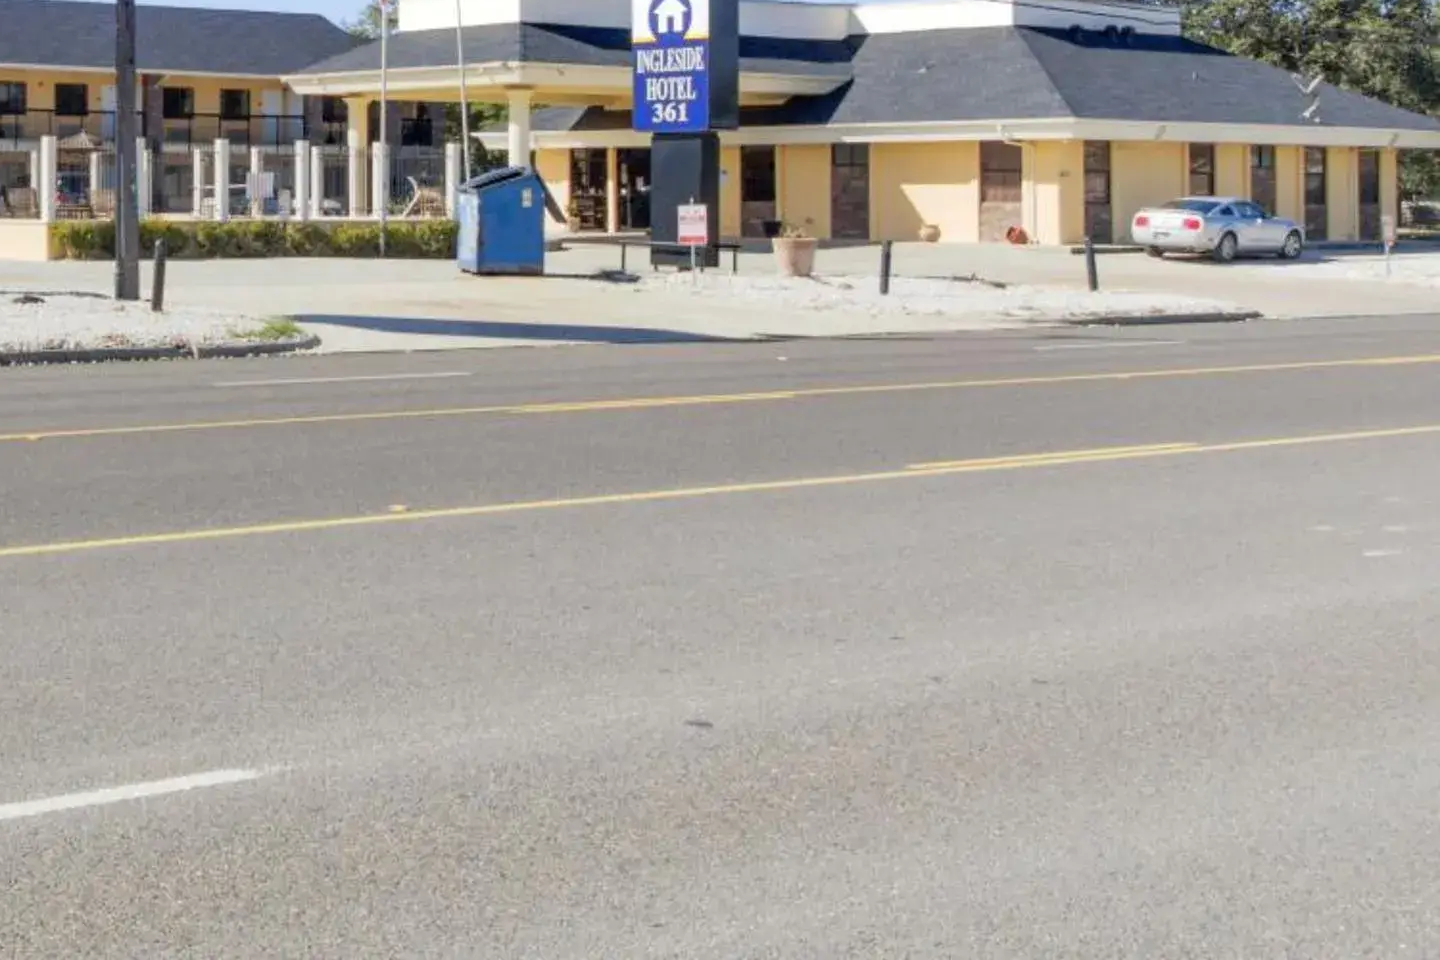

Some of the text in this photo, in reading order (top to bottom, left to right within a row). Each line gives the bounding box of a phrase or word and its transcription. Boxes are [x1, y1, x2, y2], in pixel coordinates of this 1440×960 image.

[637, 46, 705, 74] INGLESIDE
[646, 76, 696, 101] HOTEL
[652, 102, 689, 124] 361
